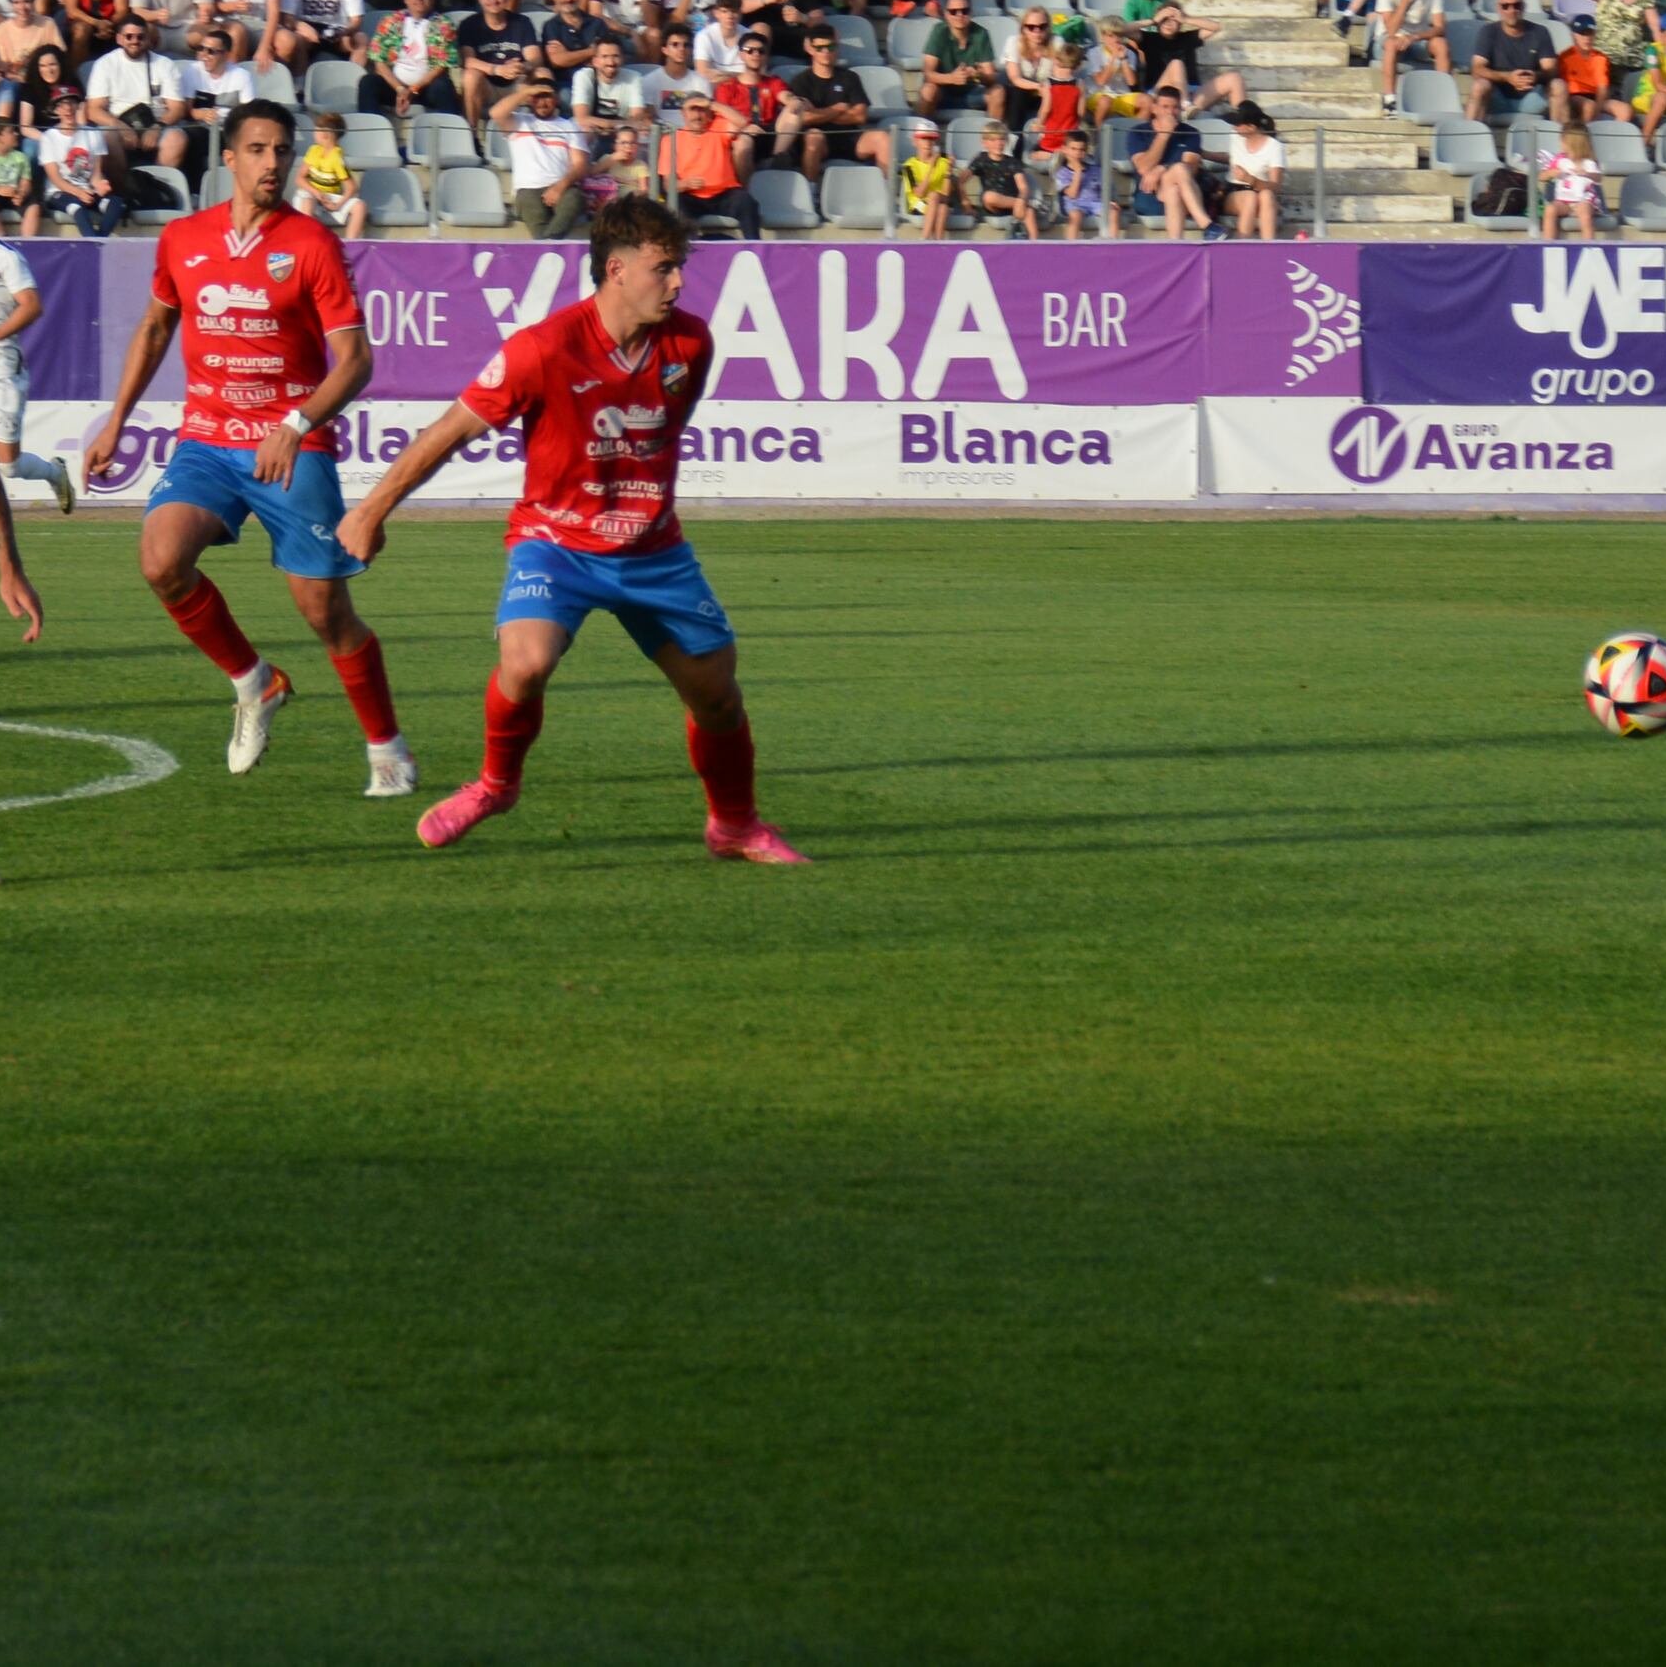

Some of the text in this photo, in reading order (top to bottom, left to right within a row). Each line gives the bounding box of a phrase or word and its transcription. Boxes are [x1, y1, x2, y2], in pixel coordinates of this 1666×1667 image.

[195, 315, 280, 332] CARLOS CHECA
[366, 291, 448, 348] OKE
[1042, 291, 1128, 348] BAR
[225, 356, 285, 367] HYUNDAI
[1532, 368, 1655, 404] grupo
[585, 440, 633, 456] CARLOS
[679, 425, 823, 464] anca
[900, 411, 1113, 465] Blanca
[1414, 424, 1614, 471] Avanza
[1453, 423, 1499, 437] GRUPO
[899, 468, 1015, 487] impresores
